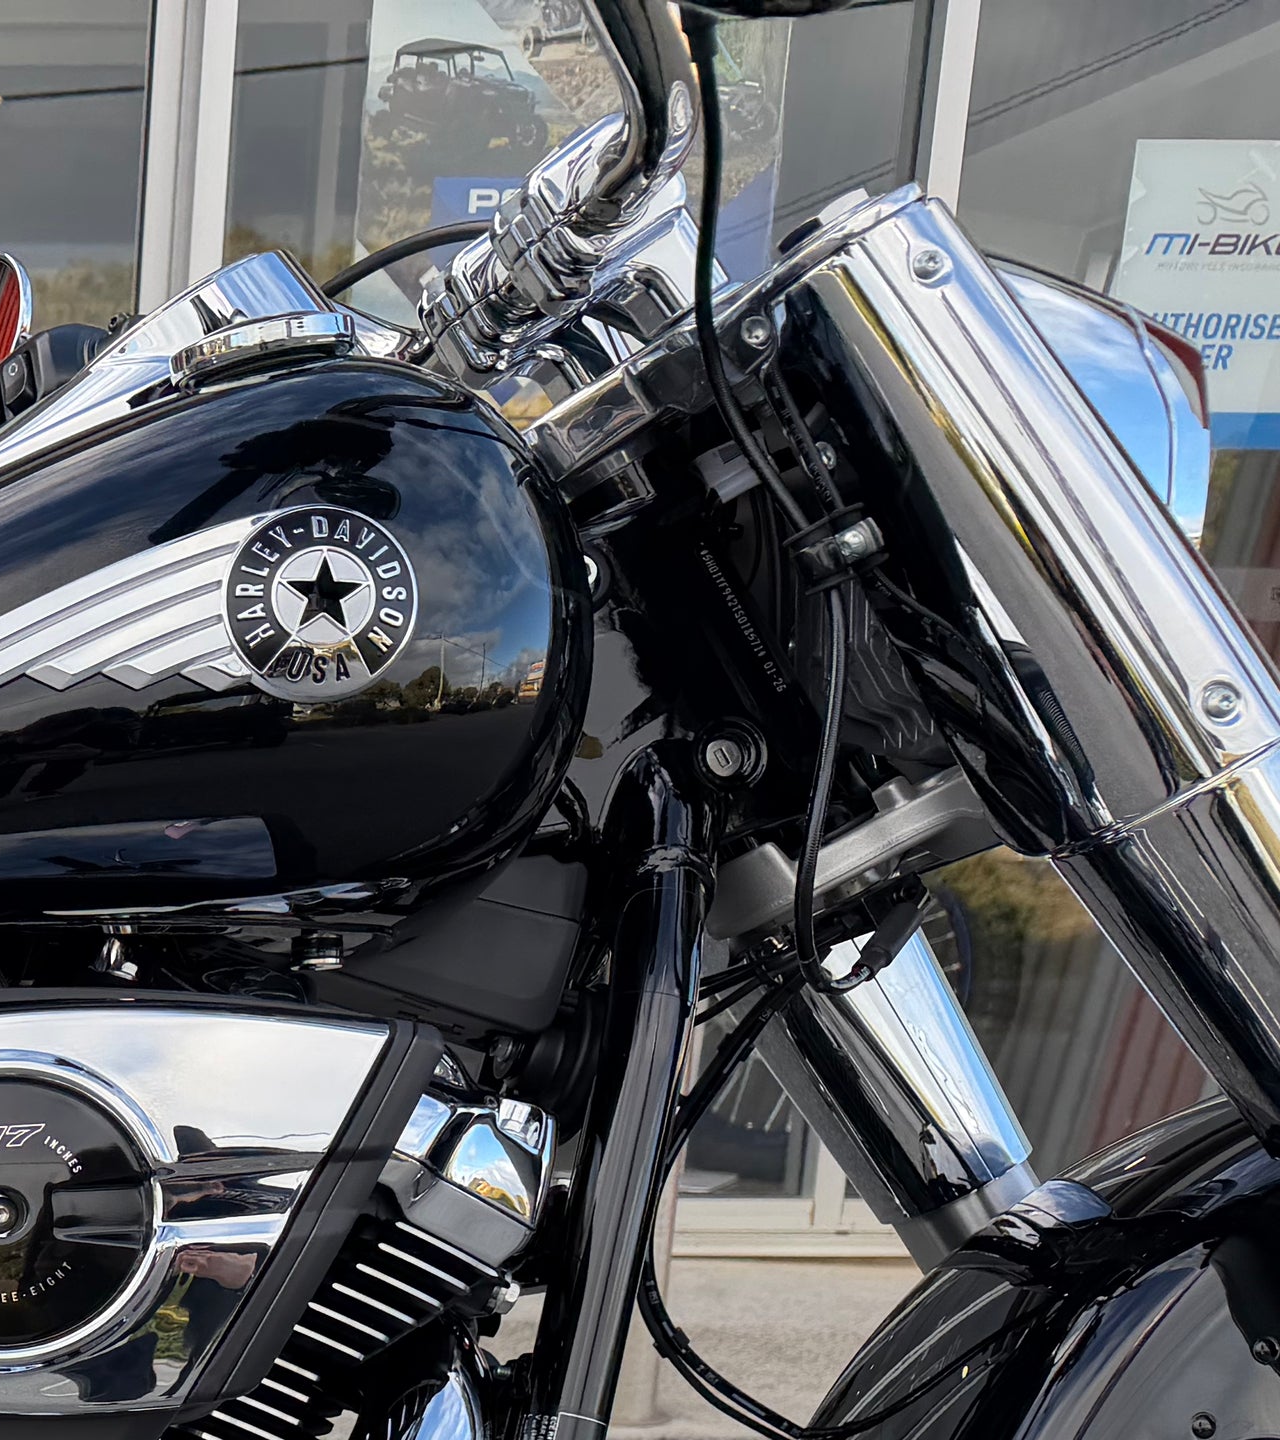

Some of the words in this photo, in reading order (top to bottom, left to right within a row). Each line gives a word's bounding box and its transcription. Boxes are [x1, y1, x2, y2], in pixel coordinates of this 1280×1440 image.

[1145, 233, 1280, 255] MI-BIK
[235, 515, 408, 654] HARLEY-DAVIDSON
[285, 649, 352, 685] USA
[44, 1134, 84, 1175] INCHES
